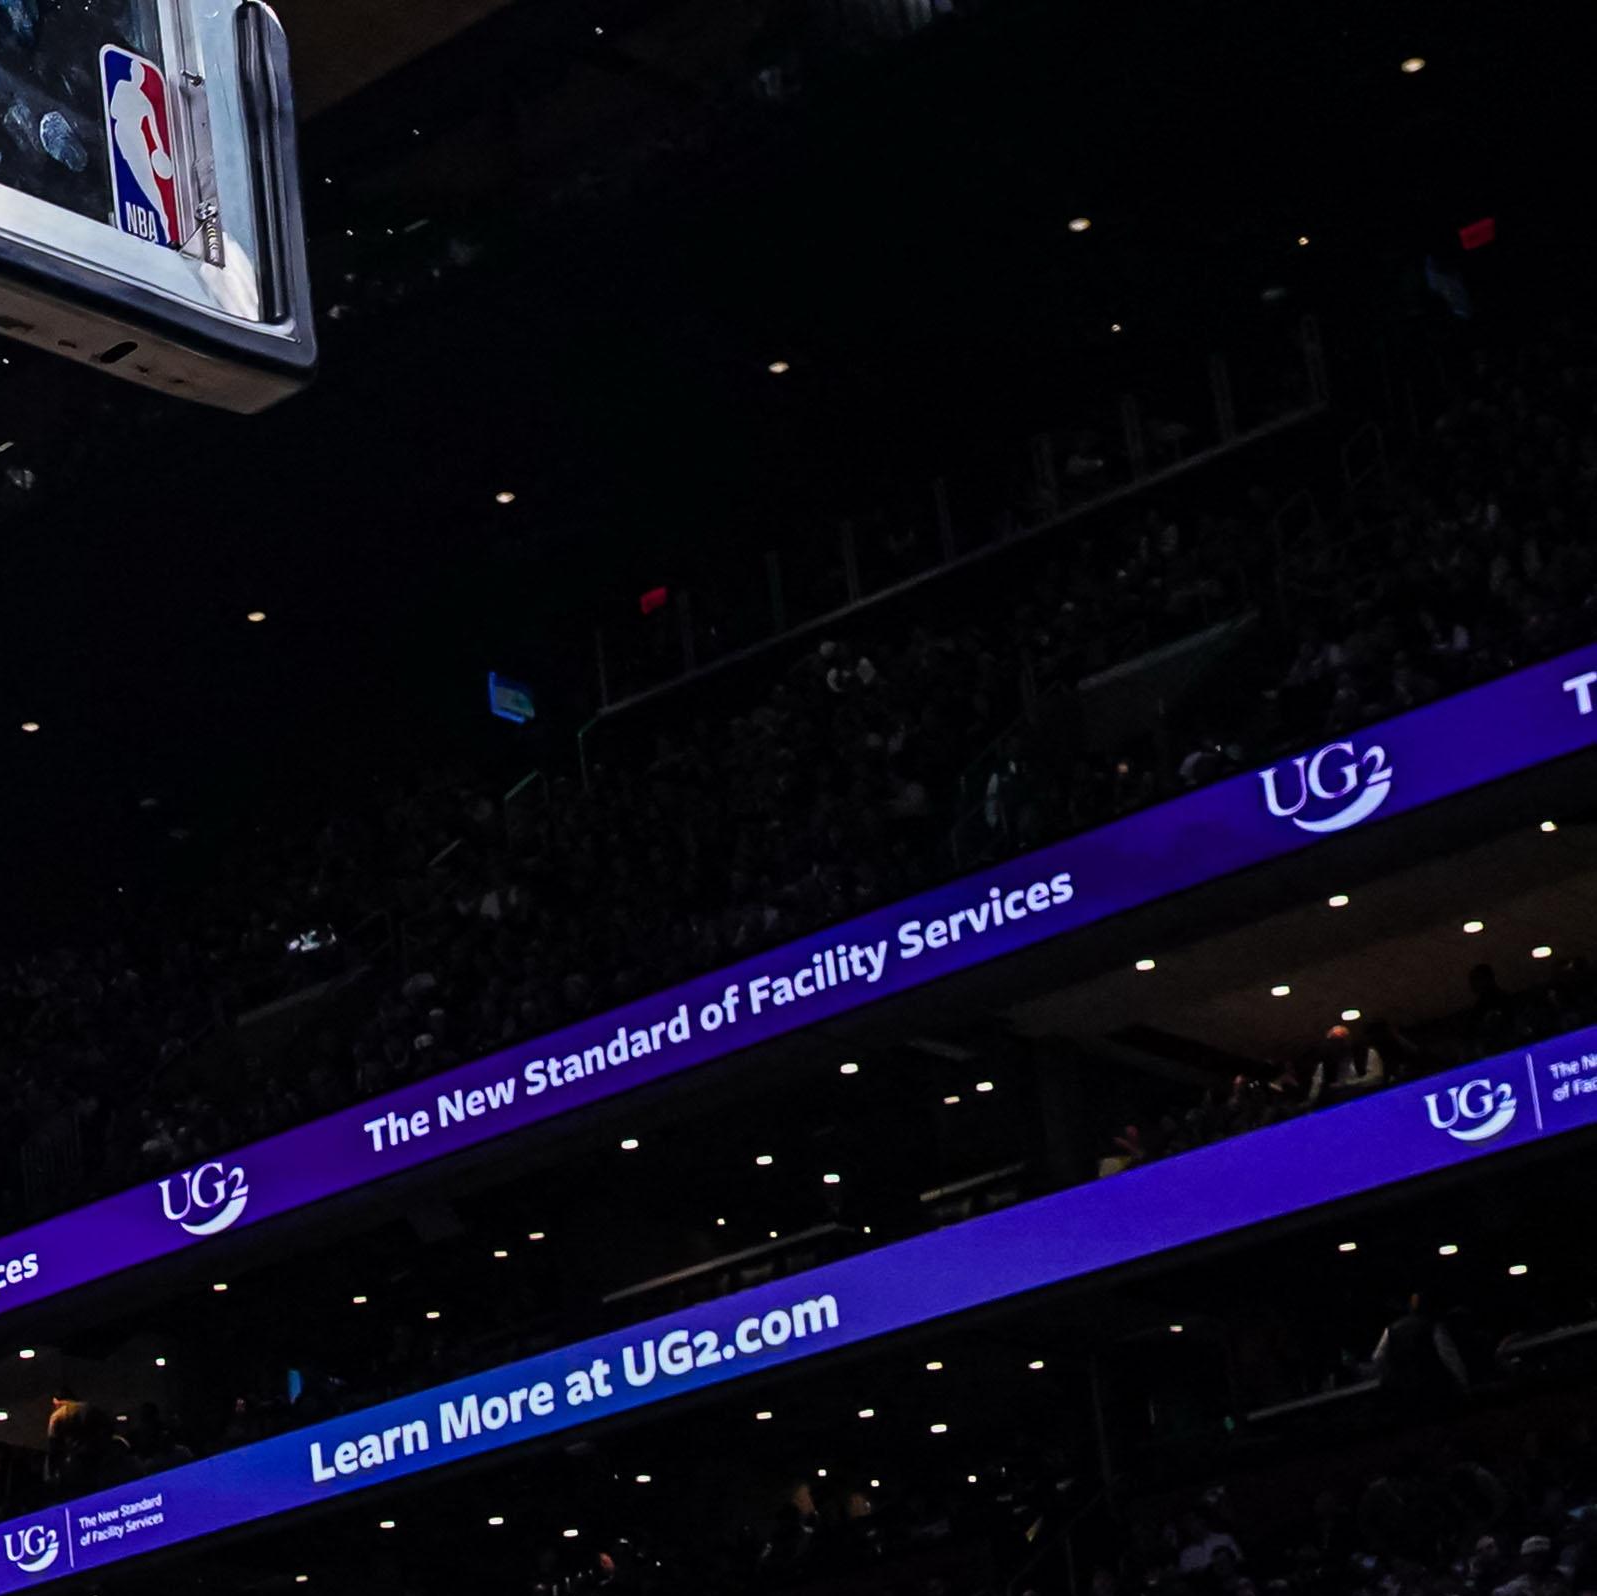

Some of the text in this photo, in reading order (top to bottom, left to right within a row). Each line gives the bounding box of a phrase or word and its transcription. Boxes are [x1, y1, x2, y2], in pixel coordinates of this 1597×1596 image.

[125, 201, 159, 243] NBA
[1261, 742, 1392, 817] UG2
[364, 873, 1073, 1151] The New Standard of Facility Services
[1423, 1078, 1517, 1130] UG2
[159, 1162, 248, 1222] UG2
[310, 1295, 839, 1482] Learn More at UG2.com
[79, 1494, 162, 1529] The New Standard
[4, 1525, 60, 1562] UG2
